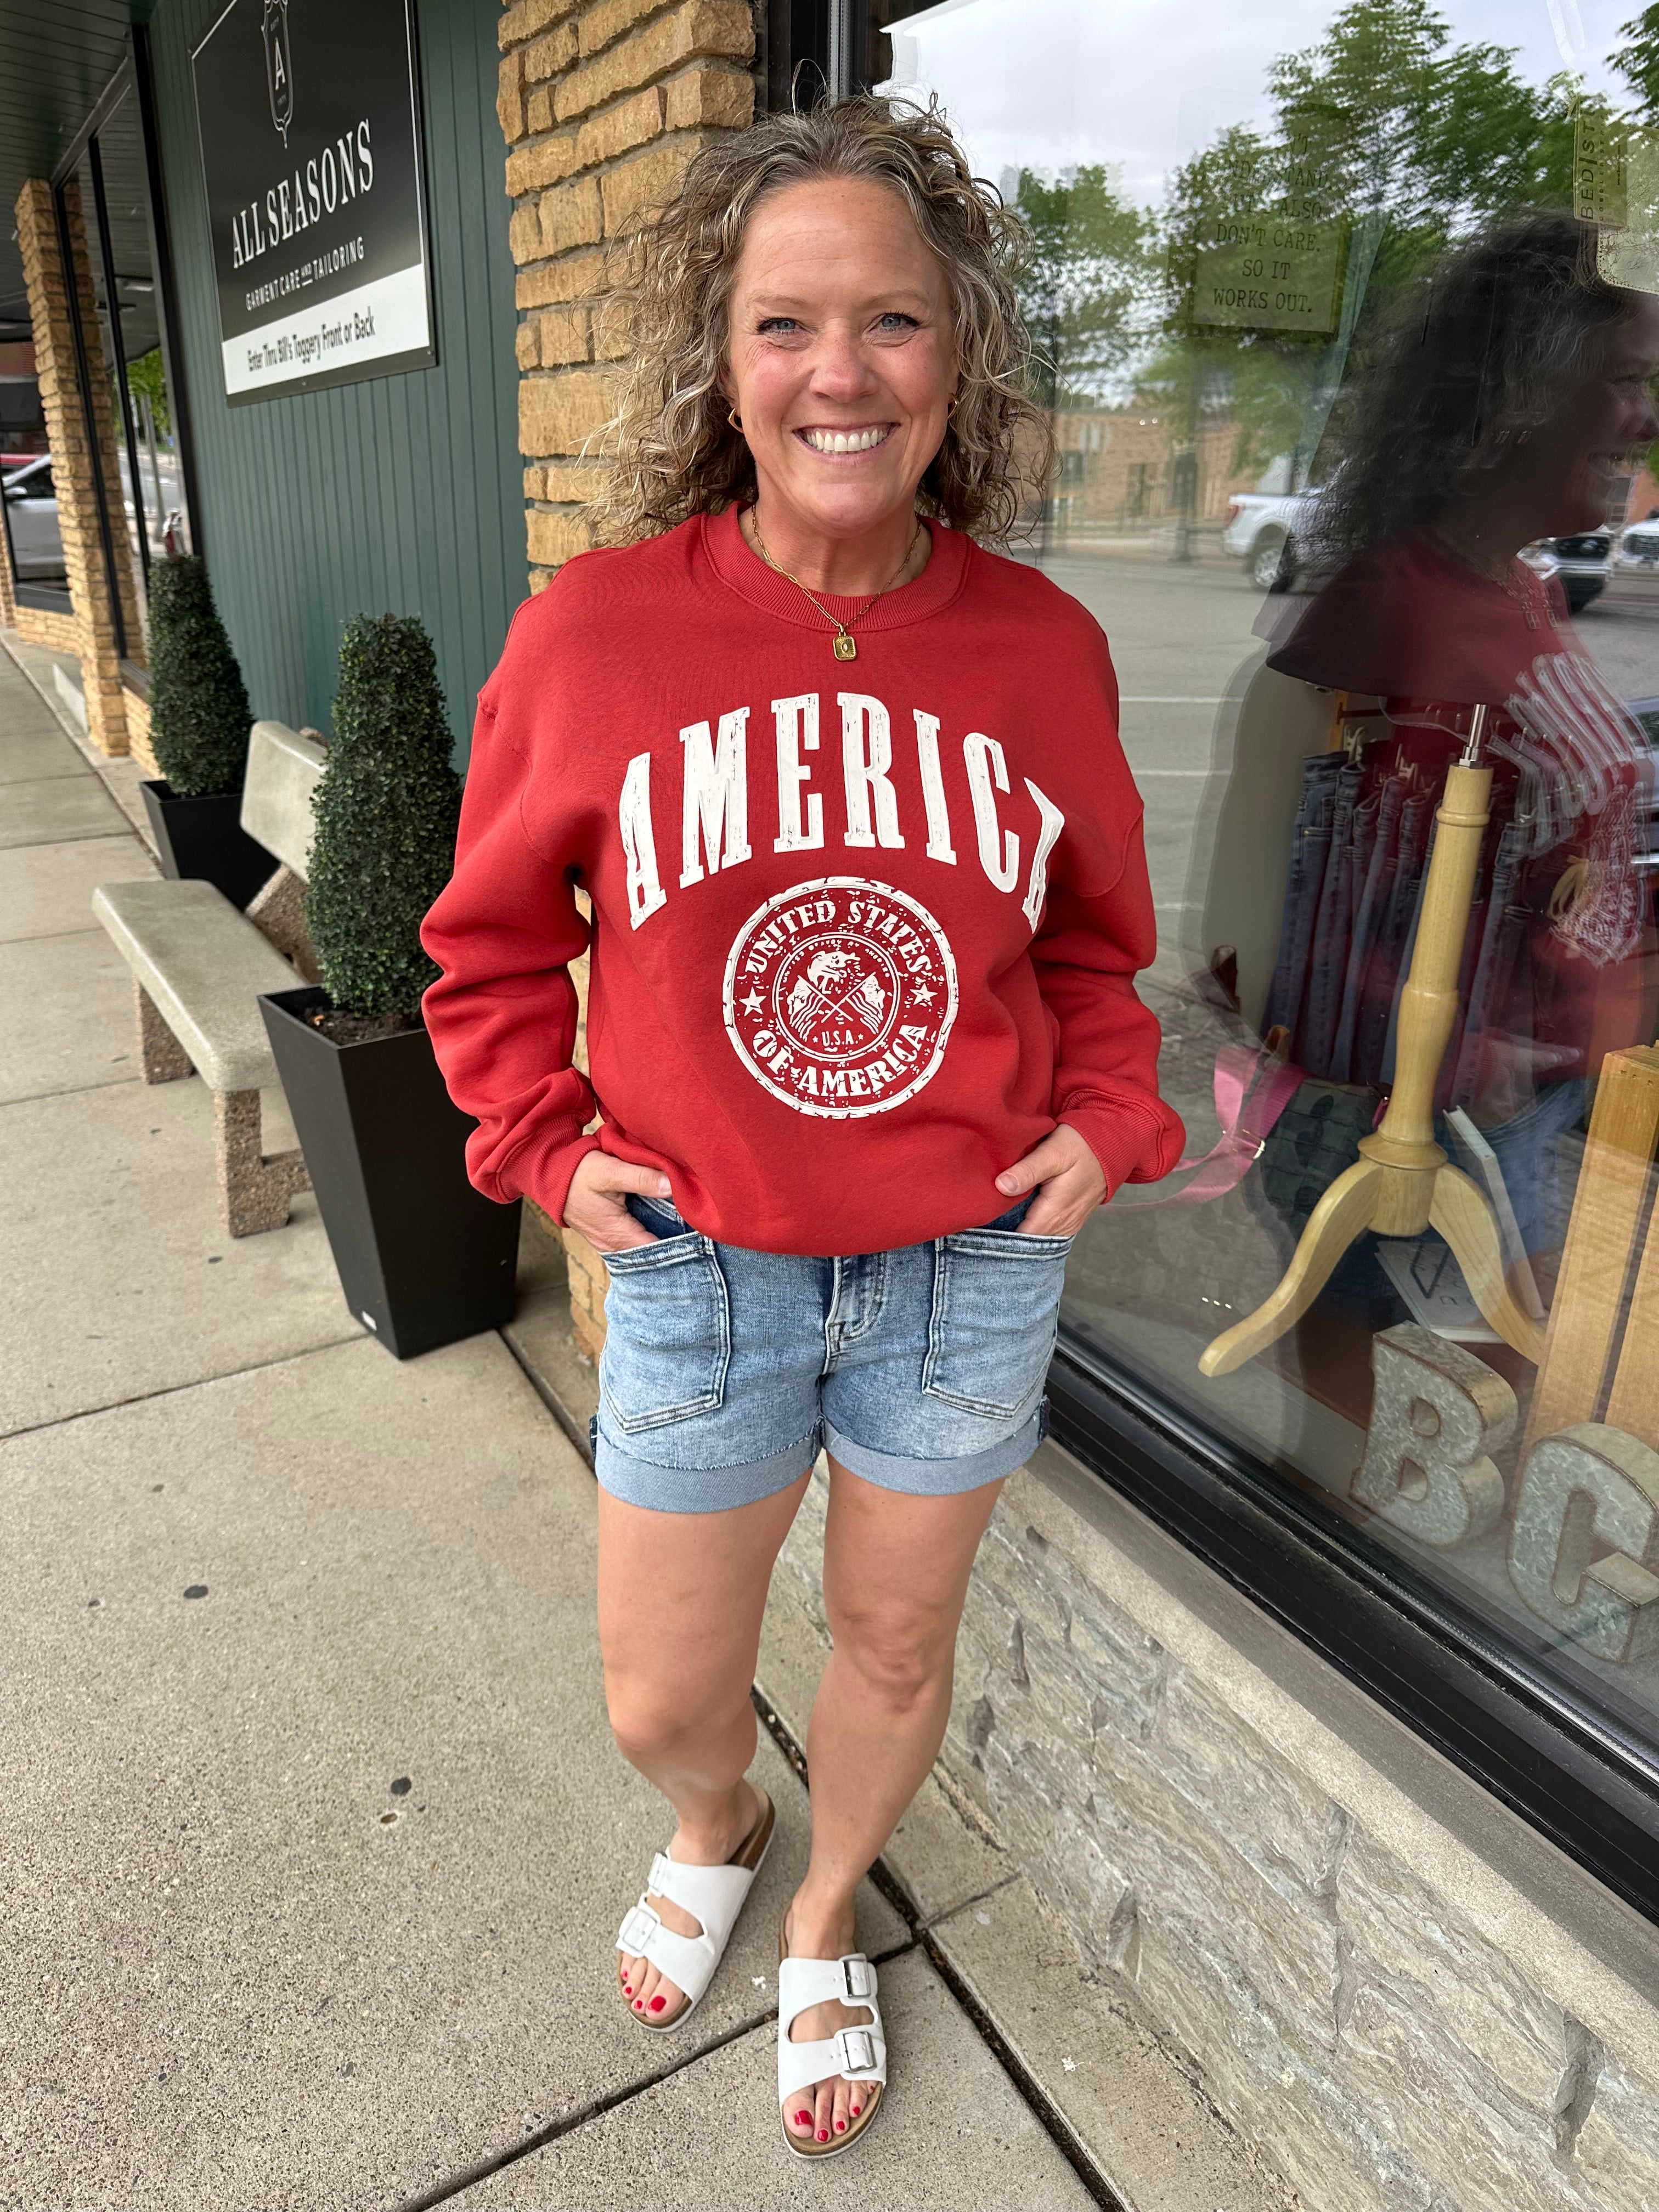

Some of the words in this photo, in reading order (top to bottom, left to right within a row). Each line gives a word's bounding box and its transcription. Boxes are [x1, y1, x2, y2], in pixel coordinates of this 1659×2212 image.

[275, 37, 286, 90] A
[233, 201, 266, 269] ALL
[267, 118, 373, 247] SEASONS
[1216, 223, 1266, 247] DON'T
[1273, 229, 1320, 252] CARE.
[1242, 259, 1263, 277] SO
[1271, 261, 1290, 280] IT
[246, 279, 279, 311] GARMENT
[280, 269, 301, 296] CARE
[313, 236, 364, 280] TAILORING
[1214, 287, 1268, 309] WORKS
[1276, 292, 1312, 313] OUT.
[247, 349, 263, 371] Enter
[321, 324, 343, 351] Front
[344, 323, 352, 343] or
[354, 306, 375, 340] Back
[619, 692, 1065, 934] AMERICA
[745, 900, 836, 973] UNITED
[848, 901, 932, 972] STATES
[753, 1030, 794, 1075] OF
[797, 1024, 928, 1097] AMERICA
[821, 1029, 859, 1047] U.S.A.
